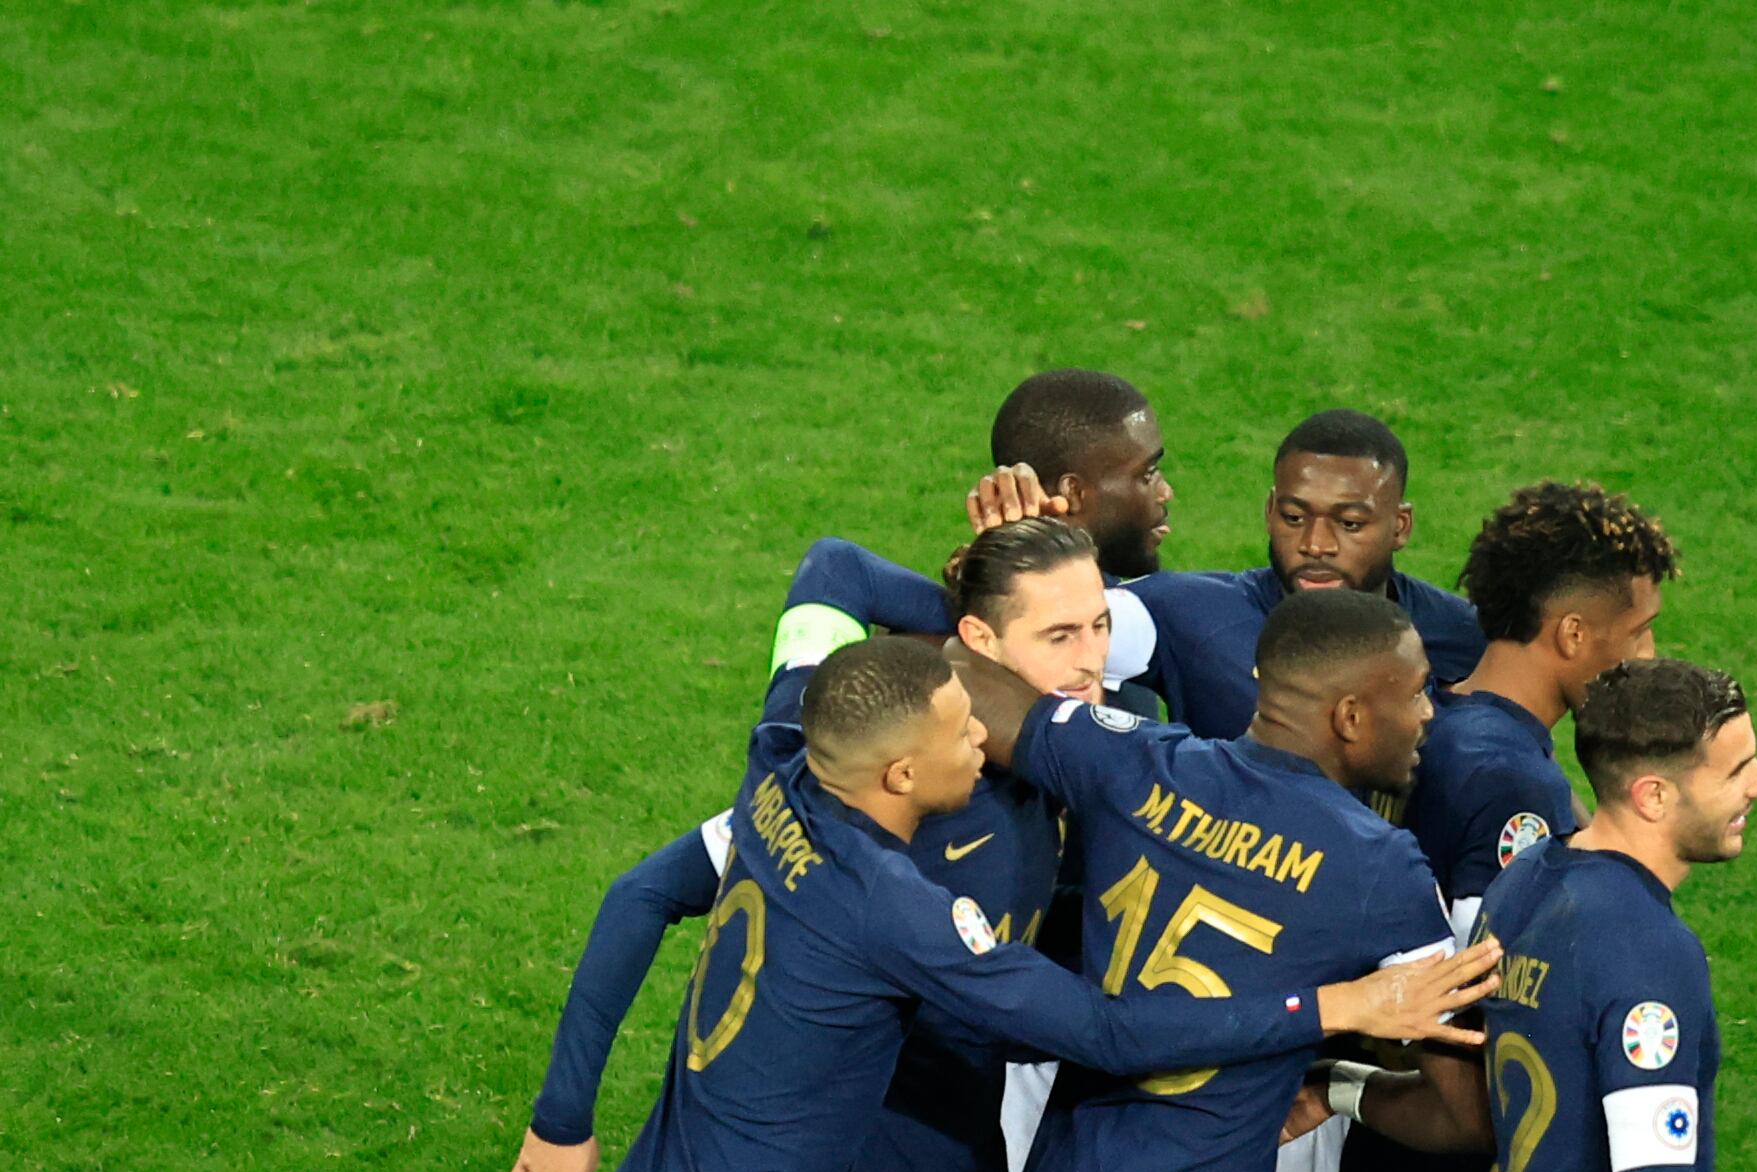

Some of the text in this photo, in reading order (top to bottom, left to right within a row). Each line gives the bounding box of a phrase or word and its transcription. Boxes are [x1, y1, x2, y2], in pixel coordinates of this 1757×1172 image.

[1131, 783, 1324, 893] M.THURAM
[687, 843, 766, 1072] 0
[1098, 854, 1285, 1096] 15
